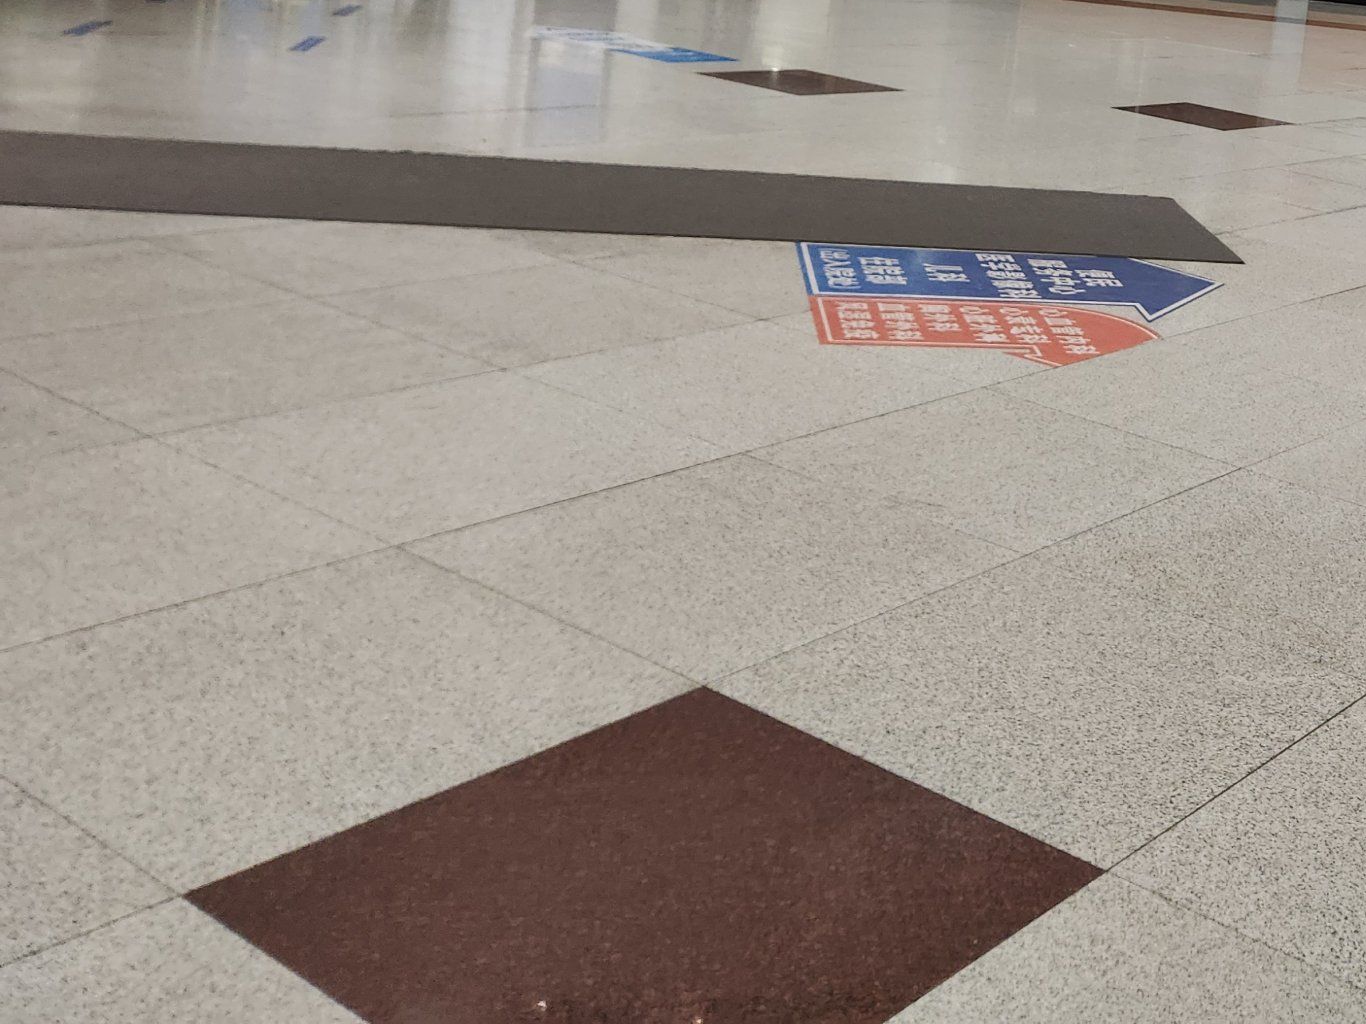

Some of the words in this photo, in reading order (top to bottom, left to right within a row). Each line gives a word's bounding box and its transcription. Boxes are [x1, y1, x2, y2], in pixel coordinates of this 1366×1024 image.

[859, 256, 908, 286] 住院部
[924, 263, 971, 283] 儿科
[975, 252, 1042, 299] 医学影像科
[1027, 258, 1088, 296] 服务中心
[1074, 269, 1124, 288] 便民
[876, 301, 924, 341] 血管外科
[1038, 307, 1101, 355] 心血管内科
